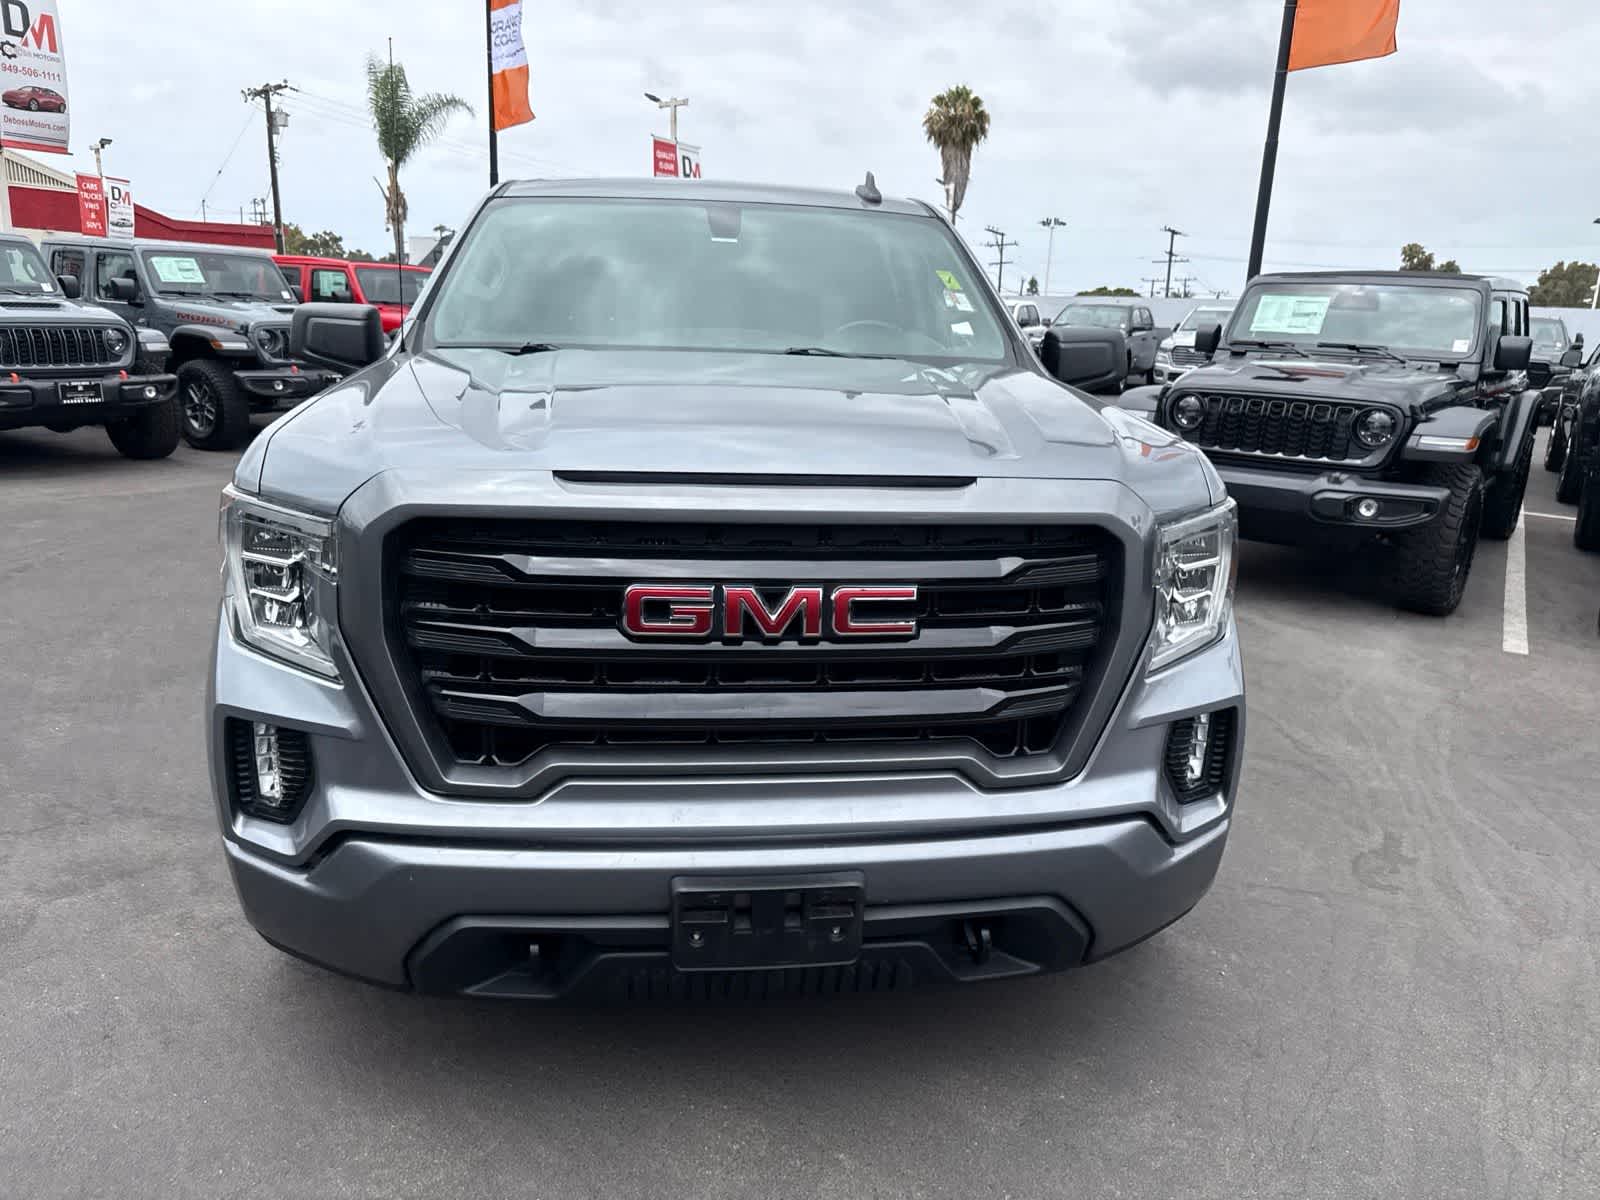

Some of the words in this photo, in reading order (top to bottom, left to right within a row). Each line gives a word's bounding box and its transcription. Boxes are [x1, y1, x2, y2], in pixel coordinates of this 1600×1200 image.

[0, 0, 58, 54] DM
[1, 62, 61, 81] 949-506-1111
[3, 114, 66, 131] DebossMotors.com
[82, 182, 98, 191] CARS
[80, 191, 102, 201] TRUCKS
[622, 583, 919, 637] GMC
